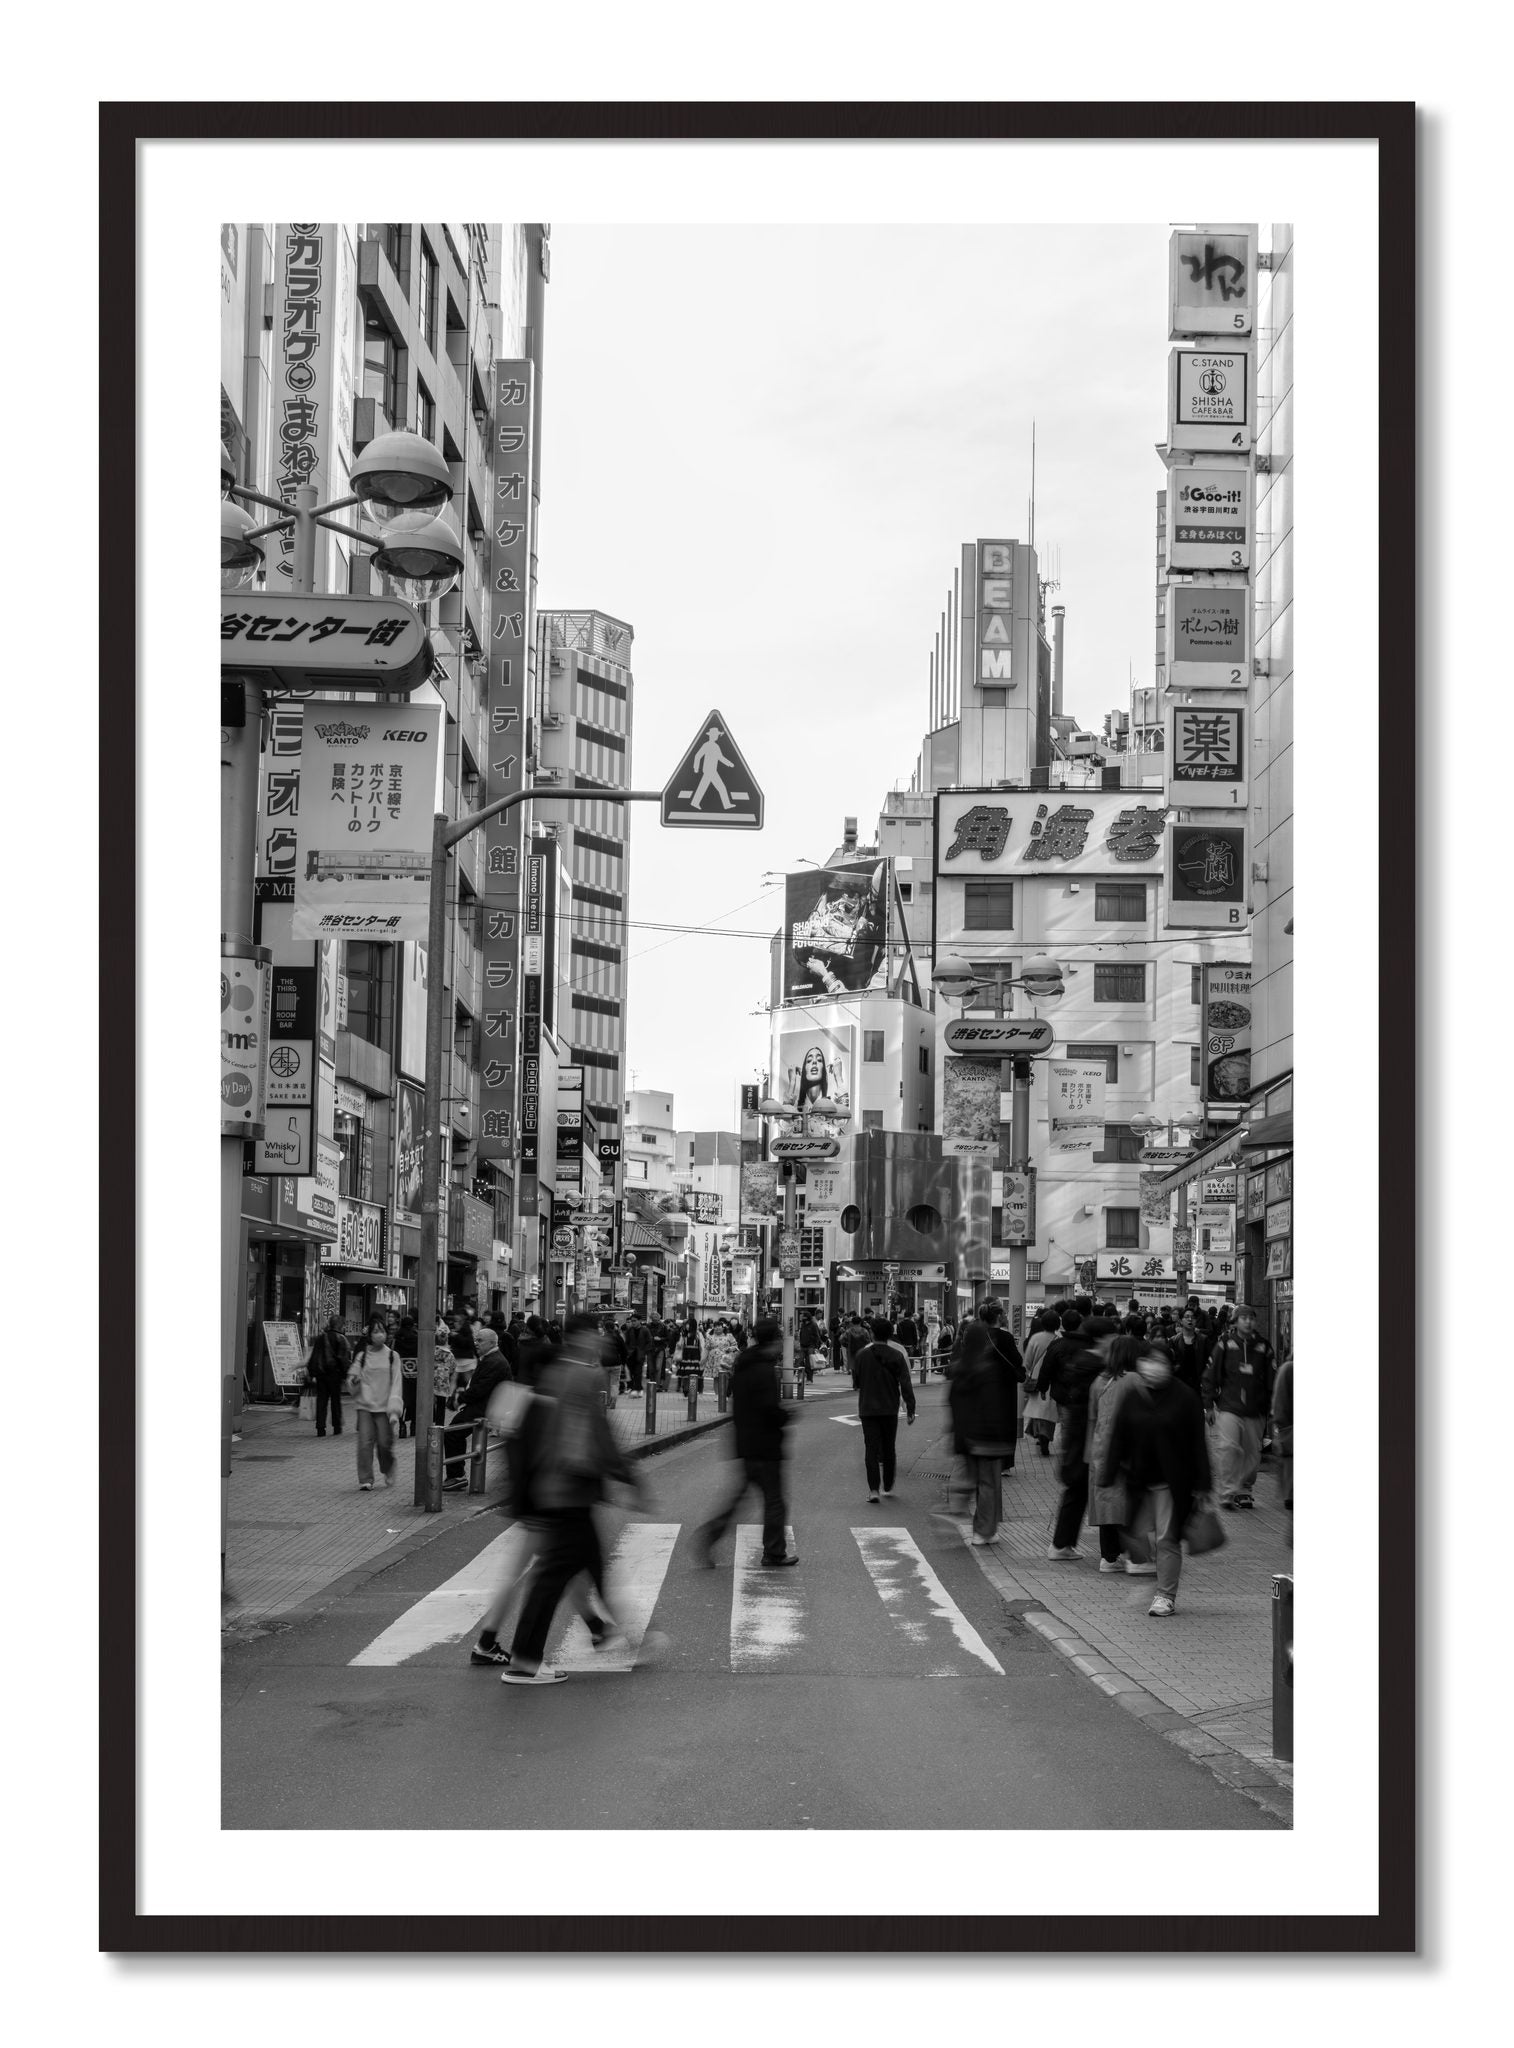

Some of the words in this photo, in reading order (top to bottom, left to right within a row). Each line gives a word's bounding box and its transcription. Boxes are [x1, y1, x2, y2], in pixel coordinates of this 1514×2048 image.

[284, 235, 322, 363] カラオケ
[1233, 314, 1245, 329] 5
[1191, 358, 1234, 368] C.STAND
[1191, 396, 1233, 406] SHISHA
[1191, 407, 1233, 415] CAFE&BAR
[1232, 432, 1243, 447] 4
[1190, 488, 1241, 502] Goo-it!
[1184, 506, 1238, 514] 渋谷宇田川町店
[1179, 529, 1242, 540] 全身もみほぐし
[1231, 550, 1242, 566] 3
[982, 543, 1012, 678] BEAM
[221, 613, 410, 646] 谷センター街
[1230, 669, 1242, 684] 2
[382, 730, 428, 743] KEIO
[1183, 714, 1230, 762] 薬
[1178, 765, 1235, 778] マツモトキヨシ
[331, 763, 346, 803] 冒険へ
[348, 763, 365, 832] カントーの
[387, 764, 403, 820] 京王線で
[1230, 789, 1238, 803] 1
[945, 804, 1168, 861] 角海老
[1178, 841, 1234, 886] 一蘭
[530, 860, 539, 893] kimono
[319, 914, 401, 927] 渋谷センター街
[1229, 908, 1240, 923] B
[482, 912, 515, 1139] カラオケ館
[951, 1027, 1047, 1040] 渋谷センター街
[1208, 1036, 1235, 1054] 6F
[232, 1081, 251, 1093] Day!
[265, 1142, 296, 1152] Whisky
[600, 1144, 619, 1155] GU
[773, 1142, 831, 1151] 渋谷センター街
[264, 1151, 283, 1159] Bank
[1110, 1256, 1165, 1277] 兆楽
[711, 1255, 719, 1294] BEER
